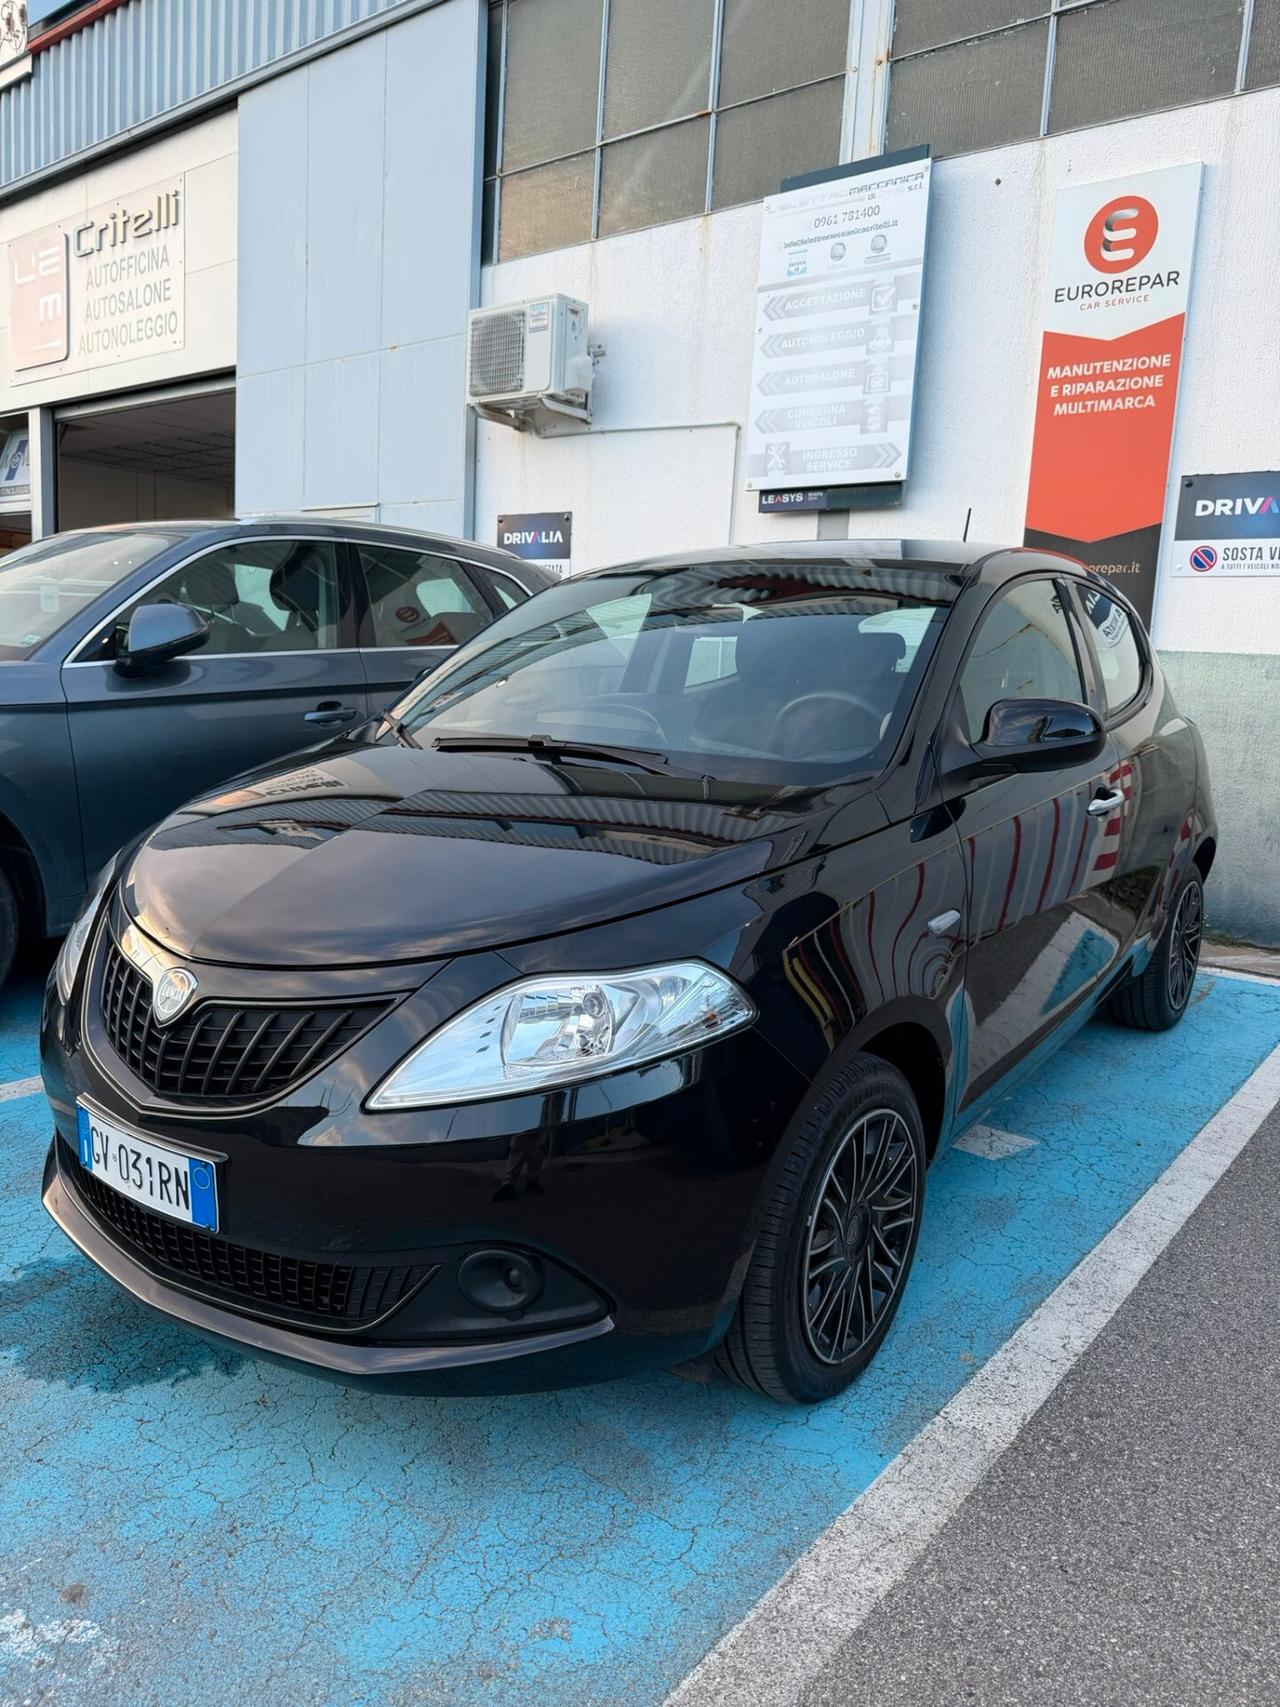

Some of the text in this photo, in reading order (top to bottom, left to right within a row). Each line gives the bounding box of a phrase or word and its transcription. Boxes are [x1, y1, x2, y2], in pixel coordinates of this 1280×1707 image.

[73, 190, 179, 257] Critelli
[814, 204, 881, 229] 0961 781400
[85, 244, 170, 291] AUTOFFICINA
[1054, 270, 1180, 304] EUROREPAR
[84, 278, 171, 322] AUTOSALONE
[784, 287, 867, 311] ACCETTAZIONE
[1079, 294, 1149, 312] CAR SERVICE
[78, 310, 178, 357] AUTONOLEGGIO
[780, 327, 865, 350] AUTONOLEGGIO
[783, 367, 855, 386] AUTOSALONE
[1047, 354, 1171, 379] MANUTENZIONE
[1050, 375, 1164, 397] E RIPARAZIONE
[1053, 395, 1155, 416] MULTIMARCA
[802, 447, 858, 461] INGRESSO
[806, 459, 853, 472] SERVICE
[762, 492, 803, 505] LEASYS
[503, 530, 563, 545] DRIVALIA
[1222, 547, 1263, 561] SOSTA
[91, 1126, 190, 1211] GV 031RN
